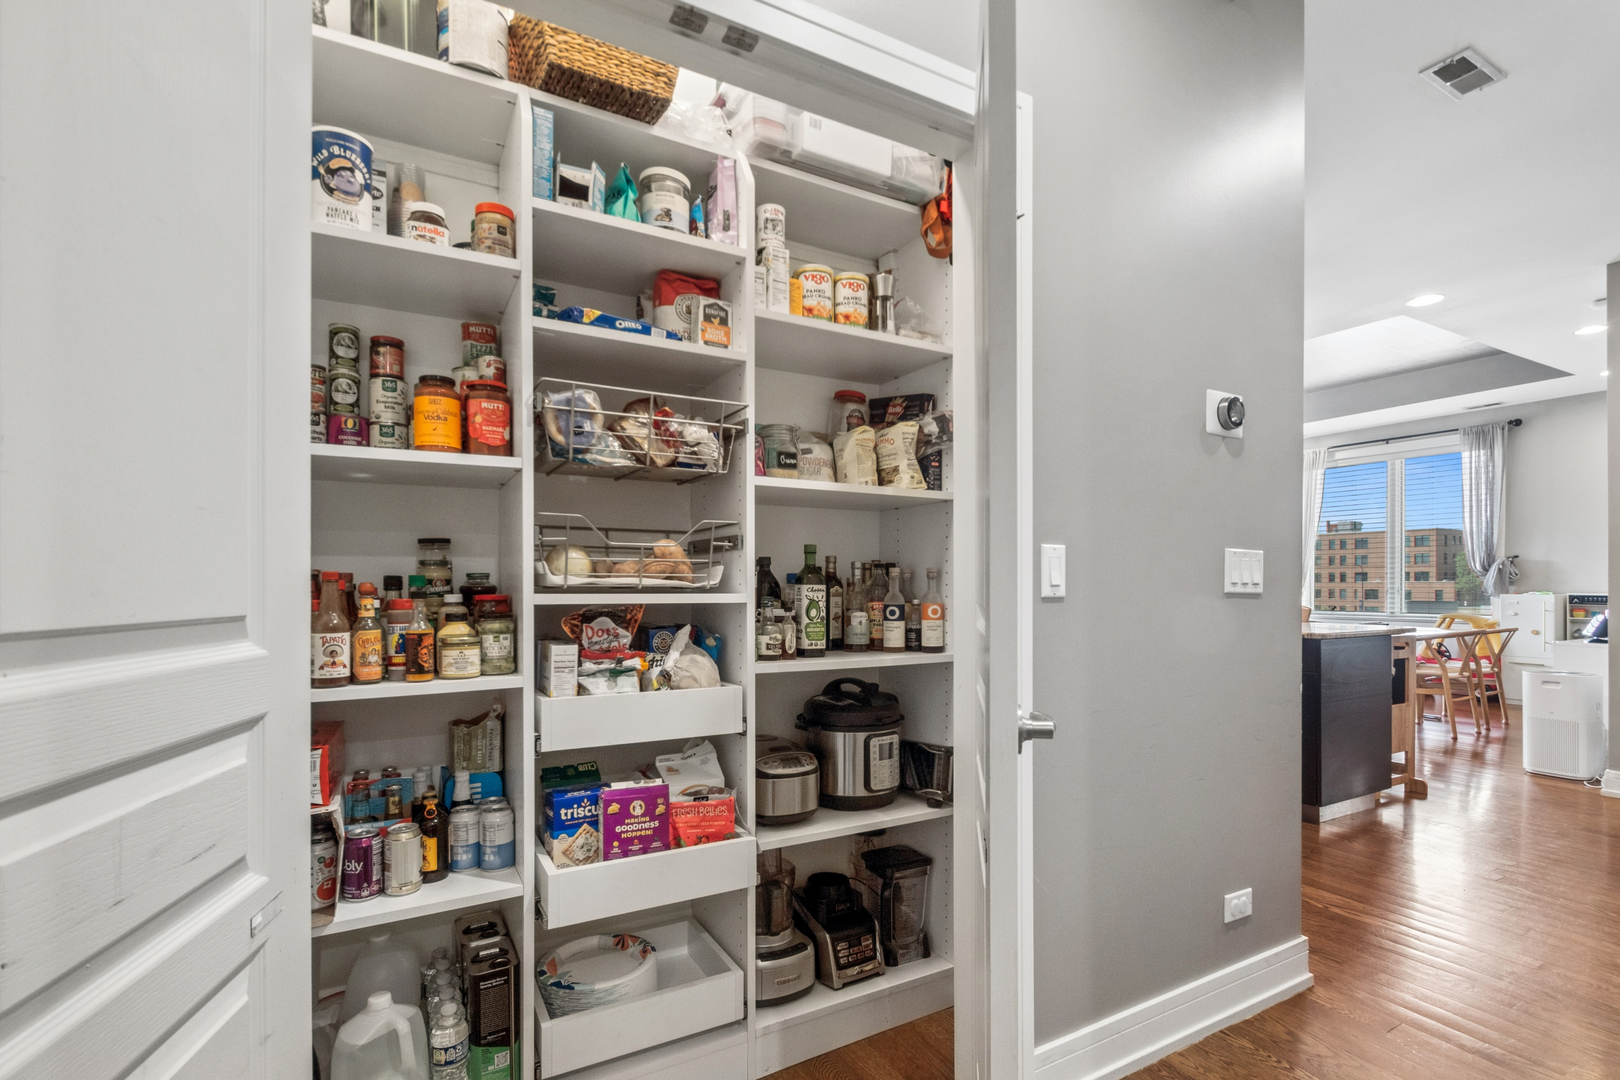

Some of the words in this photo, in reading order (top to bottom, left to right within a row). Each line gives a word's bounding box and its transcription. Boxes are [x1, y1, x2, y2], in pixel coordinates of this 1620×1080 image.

[311, 149, 328, 167] WILD
[411, 225, 445, 238] nutella
[615, 320, 642, 330] OREO
[469, 326, 494, 336] MUTTI
[671, 328, 691, 336] ALL-PU
[707, 327, 725, 337] BONE
[705, 332, 727, 343] BROTH
[470, 342, 493, 355] PIZZA
[383, 380, 396, 388] 365
[376, 399, 404, 407] Evaporated
[481, 402, 505, 411] MUTTI
[423, 413, 448, 422] Vodka
[876, 438, 895, 448] UMMO
[584, 624, 620, 640] Dot's
[560, 803, 599, 820] triscu
